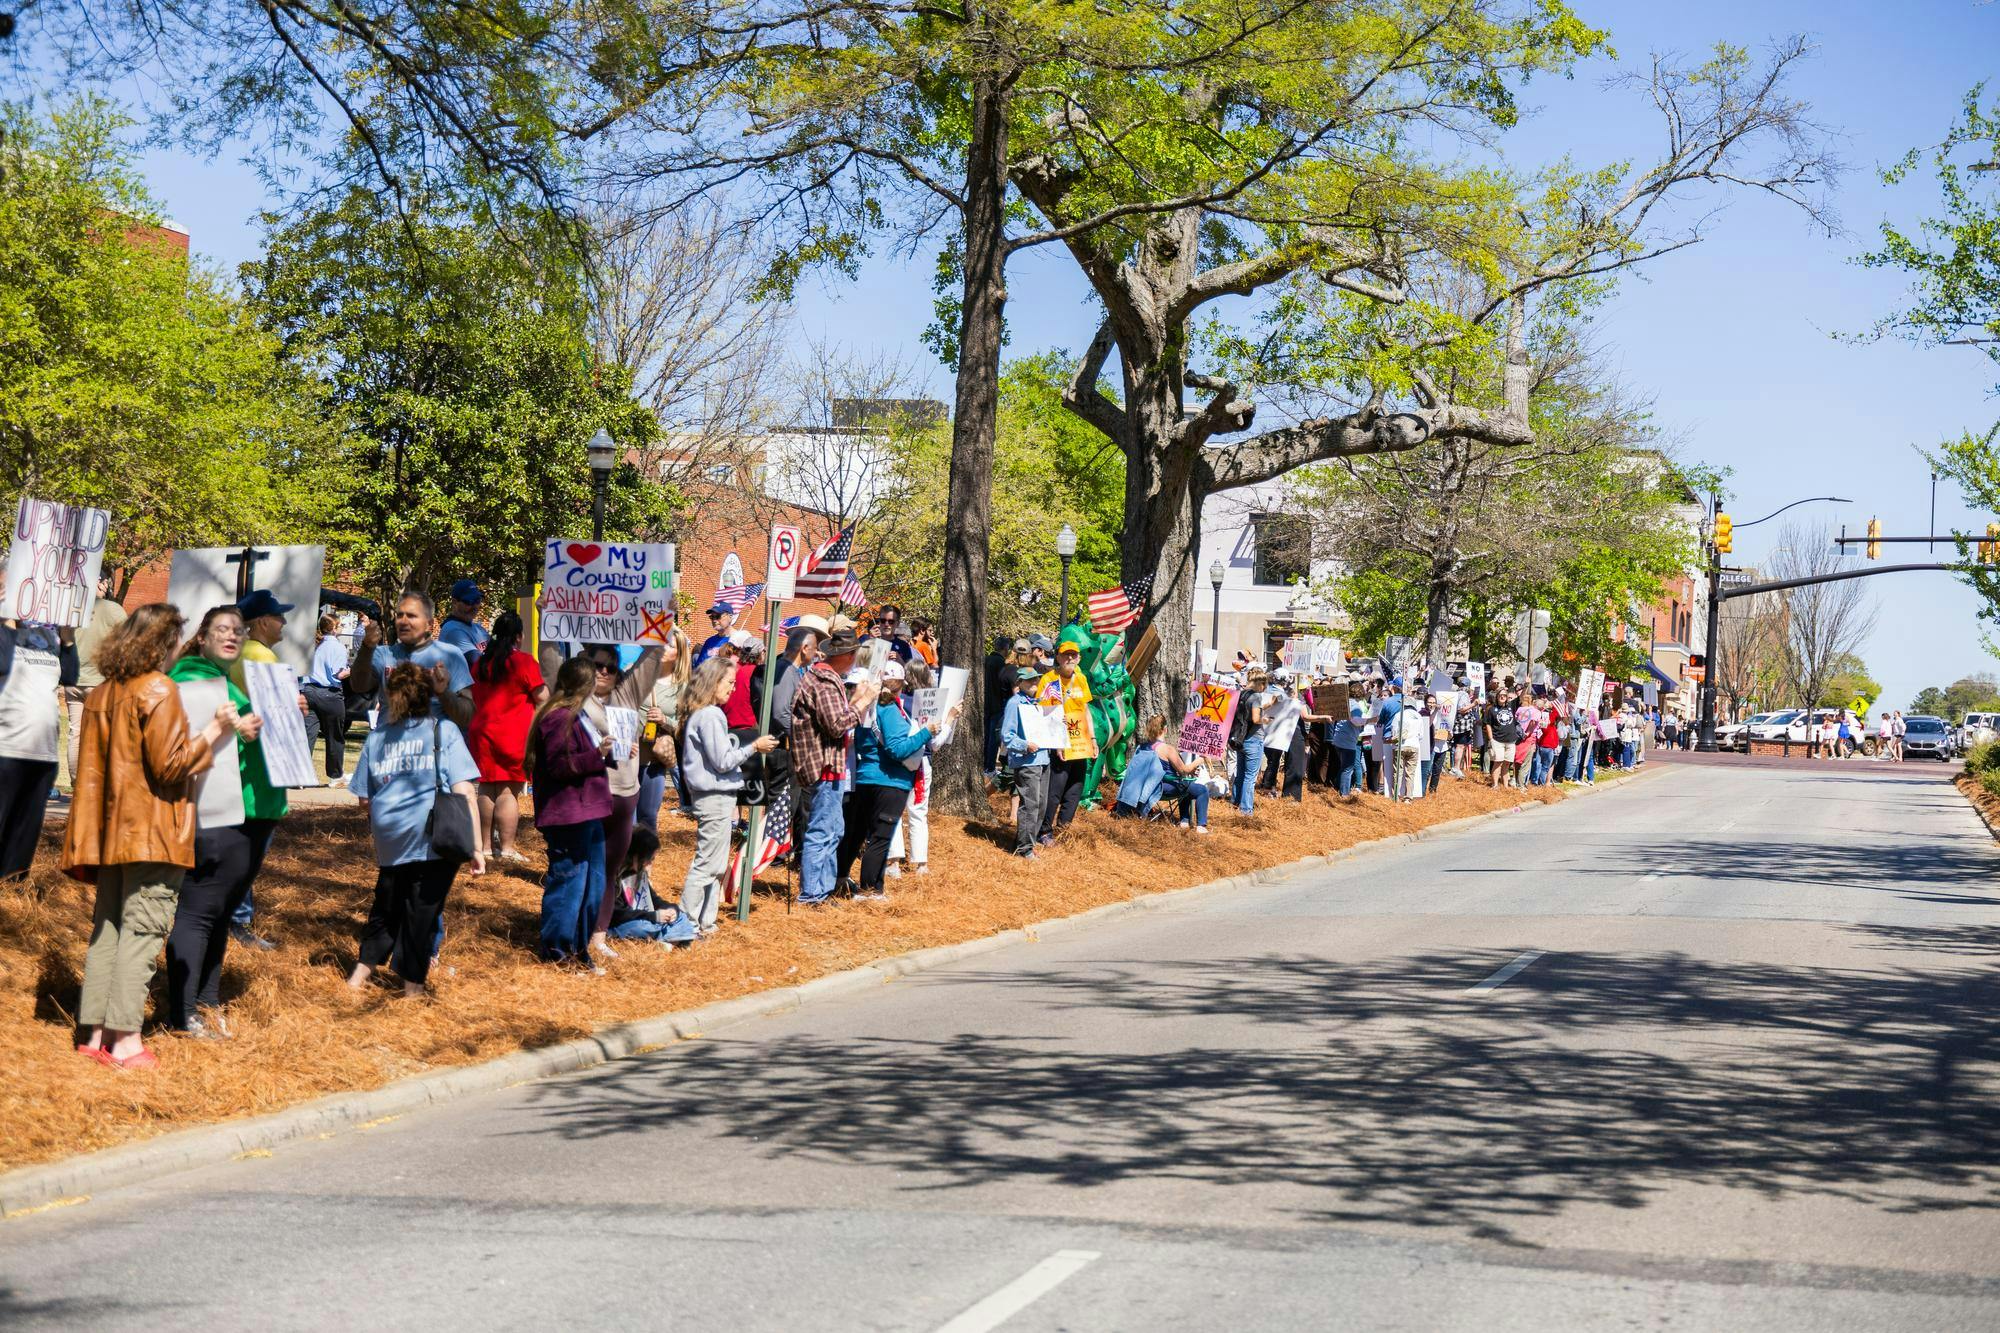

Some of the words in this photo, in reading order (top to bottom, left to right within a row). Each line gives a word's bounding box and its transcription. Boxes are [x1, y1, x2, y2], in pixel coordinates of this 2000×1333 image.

[18, 498, 108, 552] UPHOLD
[31, 542, 88, 587] YOUR
[547, 540, 567, 570] I
[608, 545, 646, 572] My
[566, 566, 646, 594] Country
[651, 569, 673, 590] BUT
[1720, 574, 1752, 583] OLLEGE
[16, 577, 89, 628] OATH
[545, 586, 619, 614] ASHAMED
[625, 596, 639, 616] of
[644, 599, 663, 615] my
[543, 613, 640, 641] GOVERNMENT
[1190, 694, 1201, 711] NO
